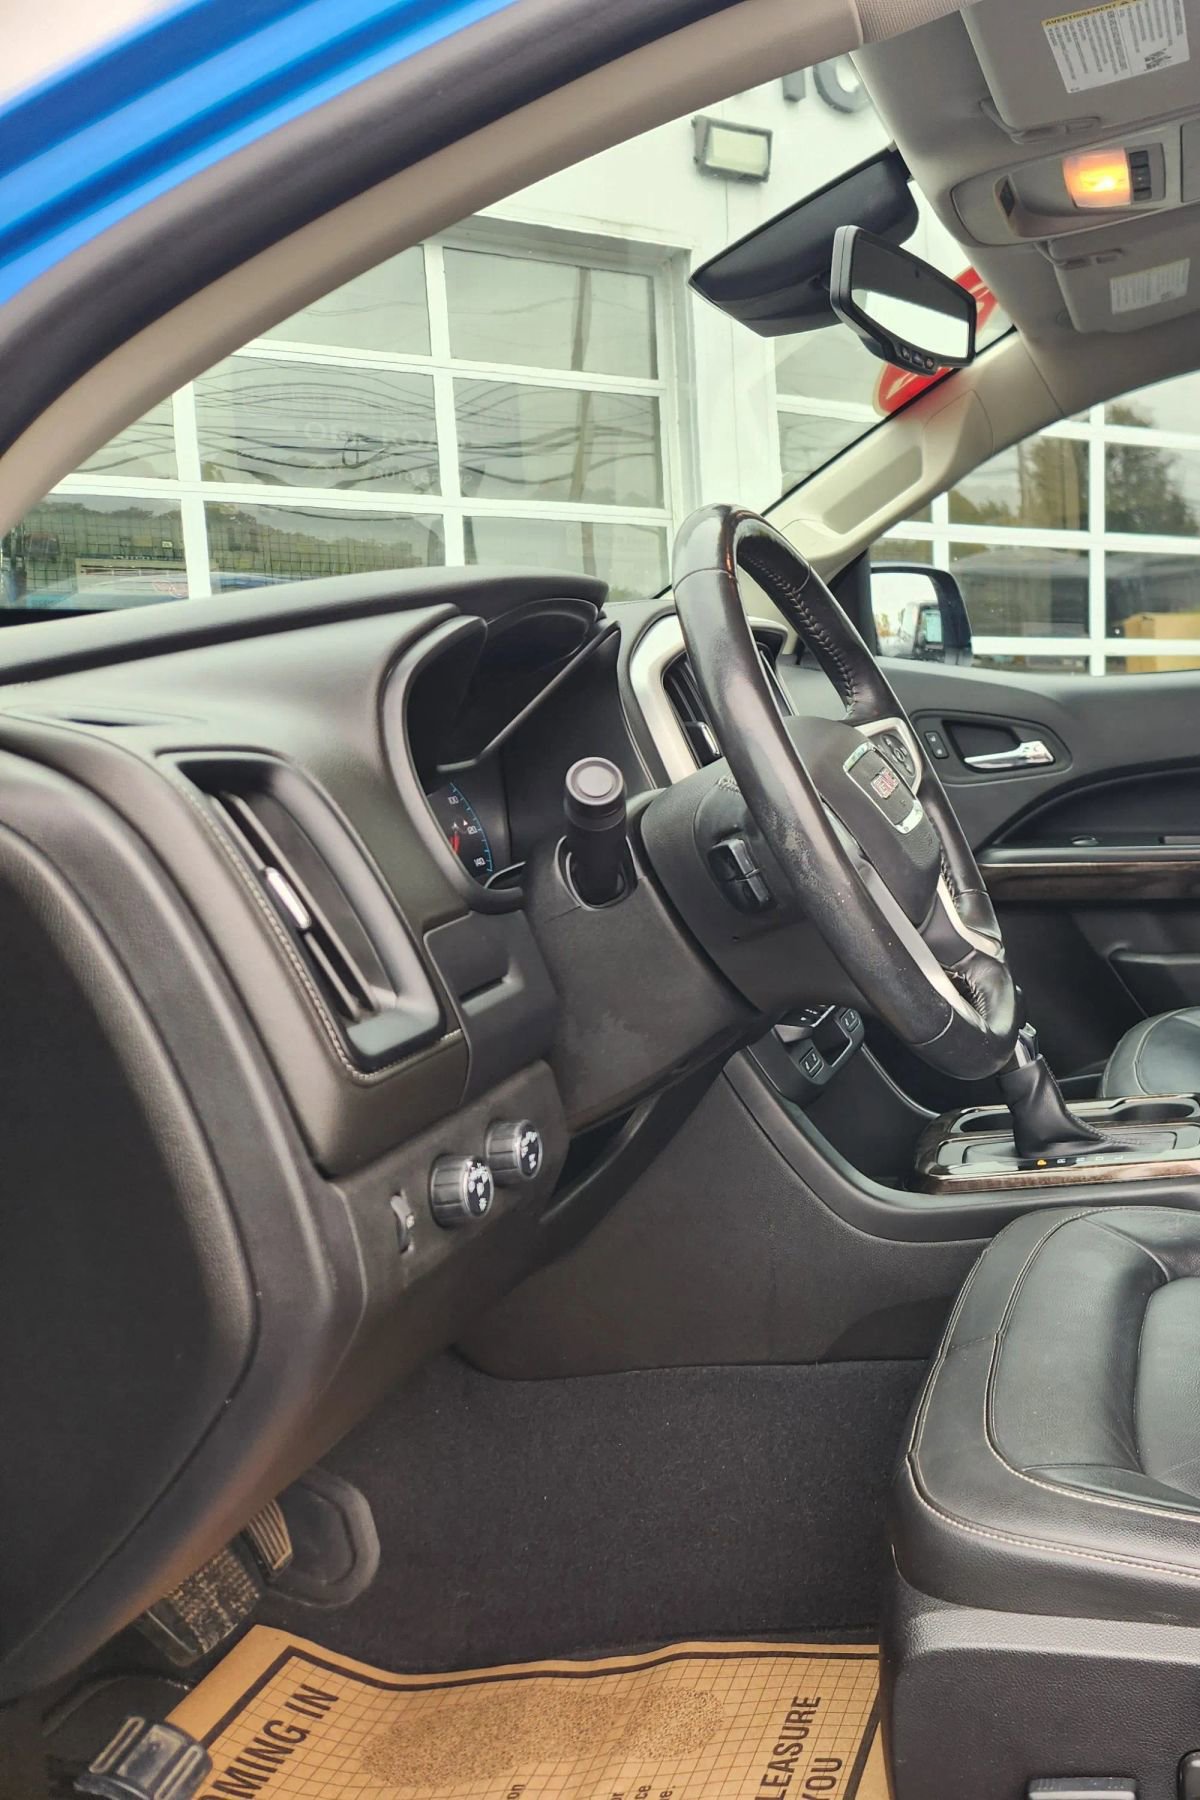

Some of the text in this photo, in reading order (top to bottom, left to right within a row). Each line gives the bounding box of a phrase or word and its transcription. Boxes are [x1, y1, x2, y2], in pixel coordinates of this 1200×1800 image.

[871, 768, 899, 799] GMC
[202, 1684, 339, 1800] MING IN
